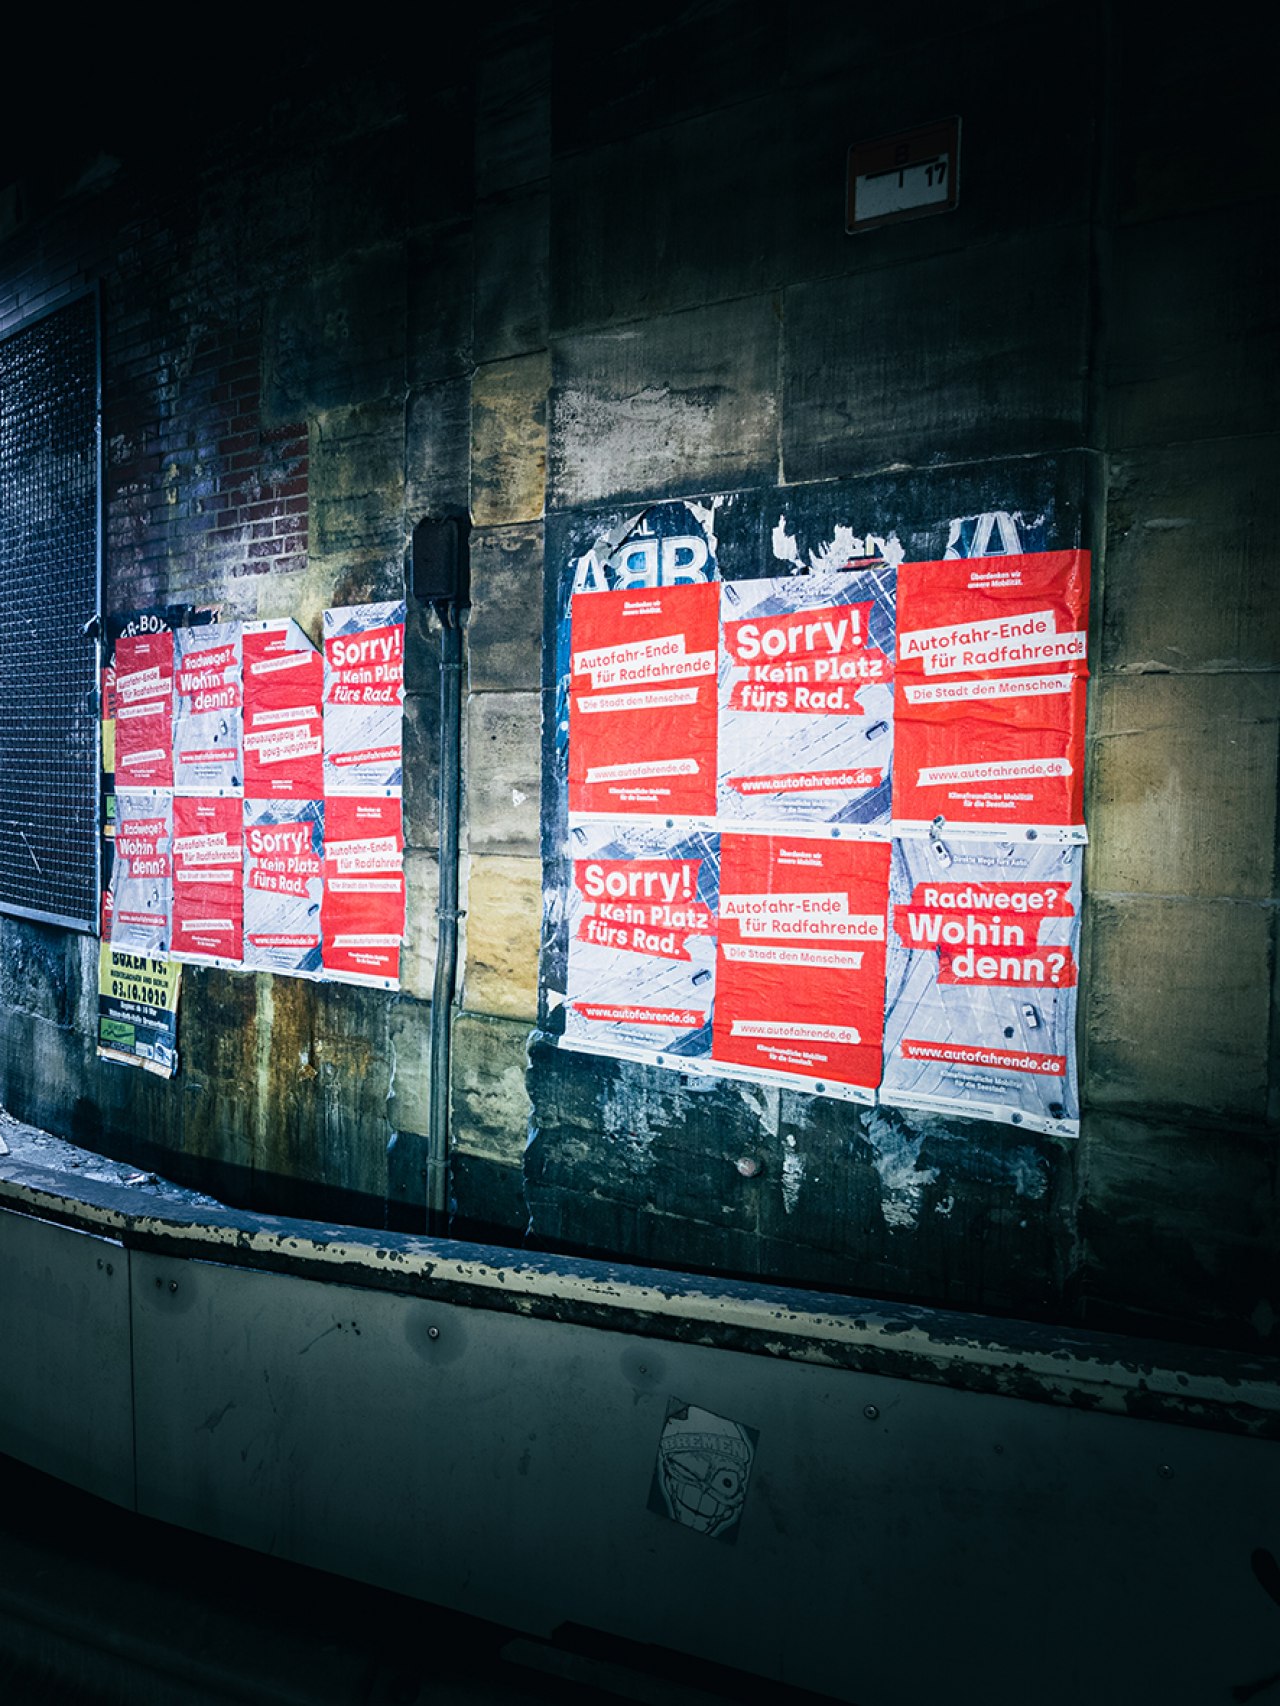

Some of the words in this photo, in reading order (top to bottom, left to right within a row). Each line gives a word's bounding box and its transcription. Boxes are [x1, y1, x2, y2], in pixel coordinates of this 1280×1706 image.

[925, 162, 947, 187] 17
[736, 610, 862, 660] Sorry!
[908, 618, 1047, 653] Autofahr-Ende
[332, 629, 401, 666] Sorry!
[579, 642, 680, 671] Autofahr-Ende
[185, 648, 231, 670] Radwege?
[754, 661, 808, 683] Kein
[815, 657, 883, 681] Platz
[931, 652, 957, 669] für
[180, 670, 221, 692] Wohin
[343, 667, 373, 684] Kein
[597, 669, 616, 684] für
[620, 658, 711, 681] Radfahrende
[195, 687, 235, 709] denn?
[334, 685, 361, 701] fürs
[363, 686, 394, 702] Rad.
[741, 685, 788, 708] fürs
[795, 687, 850, 709] Rad.
[913, 690, 932, 700] Die
[935, 686, 969, 698] Stadt
[972, 684, 995, 696] den
[998, 679, 1067, 694] Menschen.
[600, 696, 624, 708] Stadt
[594, 762, 692, 780] www.autofahrende.de
[741, 772, 873, 791] www.autofahrende.de
[928, 762, 1063, 781] www.autofahrende.de
[123, 821, 163, 836] Radwege?
[250, 825, 310, 854] Sorry!
[119, 838, 154, 855] Wohin
[329, 841, 394, 856] Autofahr-Ende
[132, 857, 166, 875] denn?
[260, 857, 286, 872] Kein
[287, 856, 319, 873] Platz
[340, 858, 352, 869] für
[253, 870, 277, 889] fürs
[278, 875, 305, 894] Rad.
[584, 864, 692, 902] Sorry!
[726, 898, 841, 914] Autofahr-Ende
[924, 887, 1058, 912] Radwege?
[600, 903, 645, 924] Kein
[651, 906, 708, 928] Platz
[587, 920, 628, 945] fürs
[633, 928, 680, 955] Rad.
[745, 918, 767, 932] für
[772, 919, 878, 936] Radfahrende
[908, 913, 1024, 946] Wohin
[730, 948, 746, 957] Die
[748, 949, 776, 960] Stadt
[779, 951, 797, 961] den
[800, 952, 857, 965] Menschen.
[951, 948, 1066, 983] denn?
[112, 980, 167, 1007] 03.10.2020
[586, 1007, 696, 1025] www.autofahrende.de
[740, 1024, 852, 1041] www.autofahrende.de
[908, 1045, 1061, 1072] www.autofahrende.de
[663, 1434, 747, 1459] BREMEN
